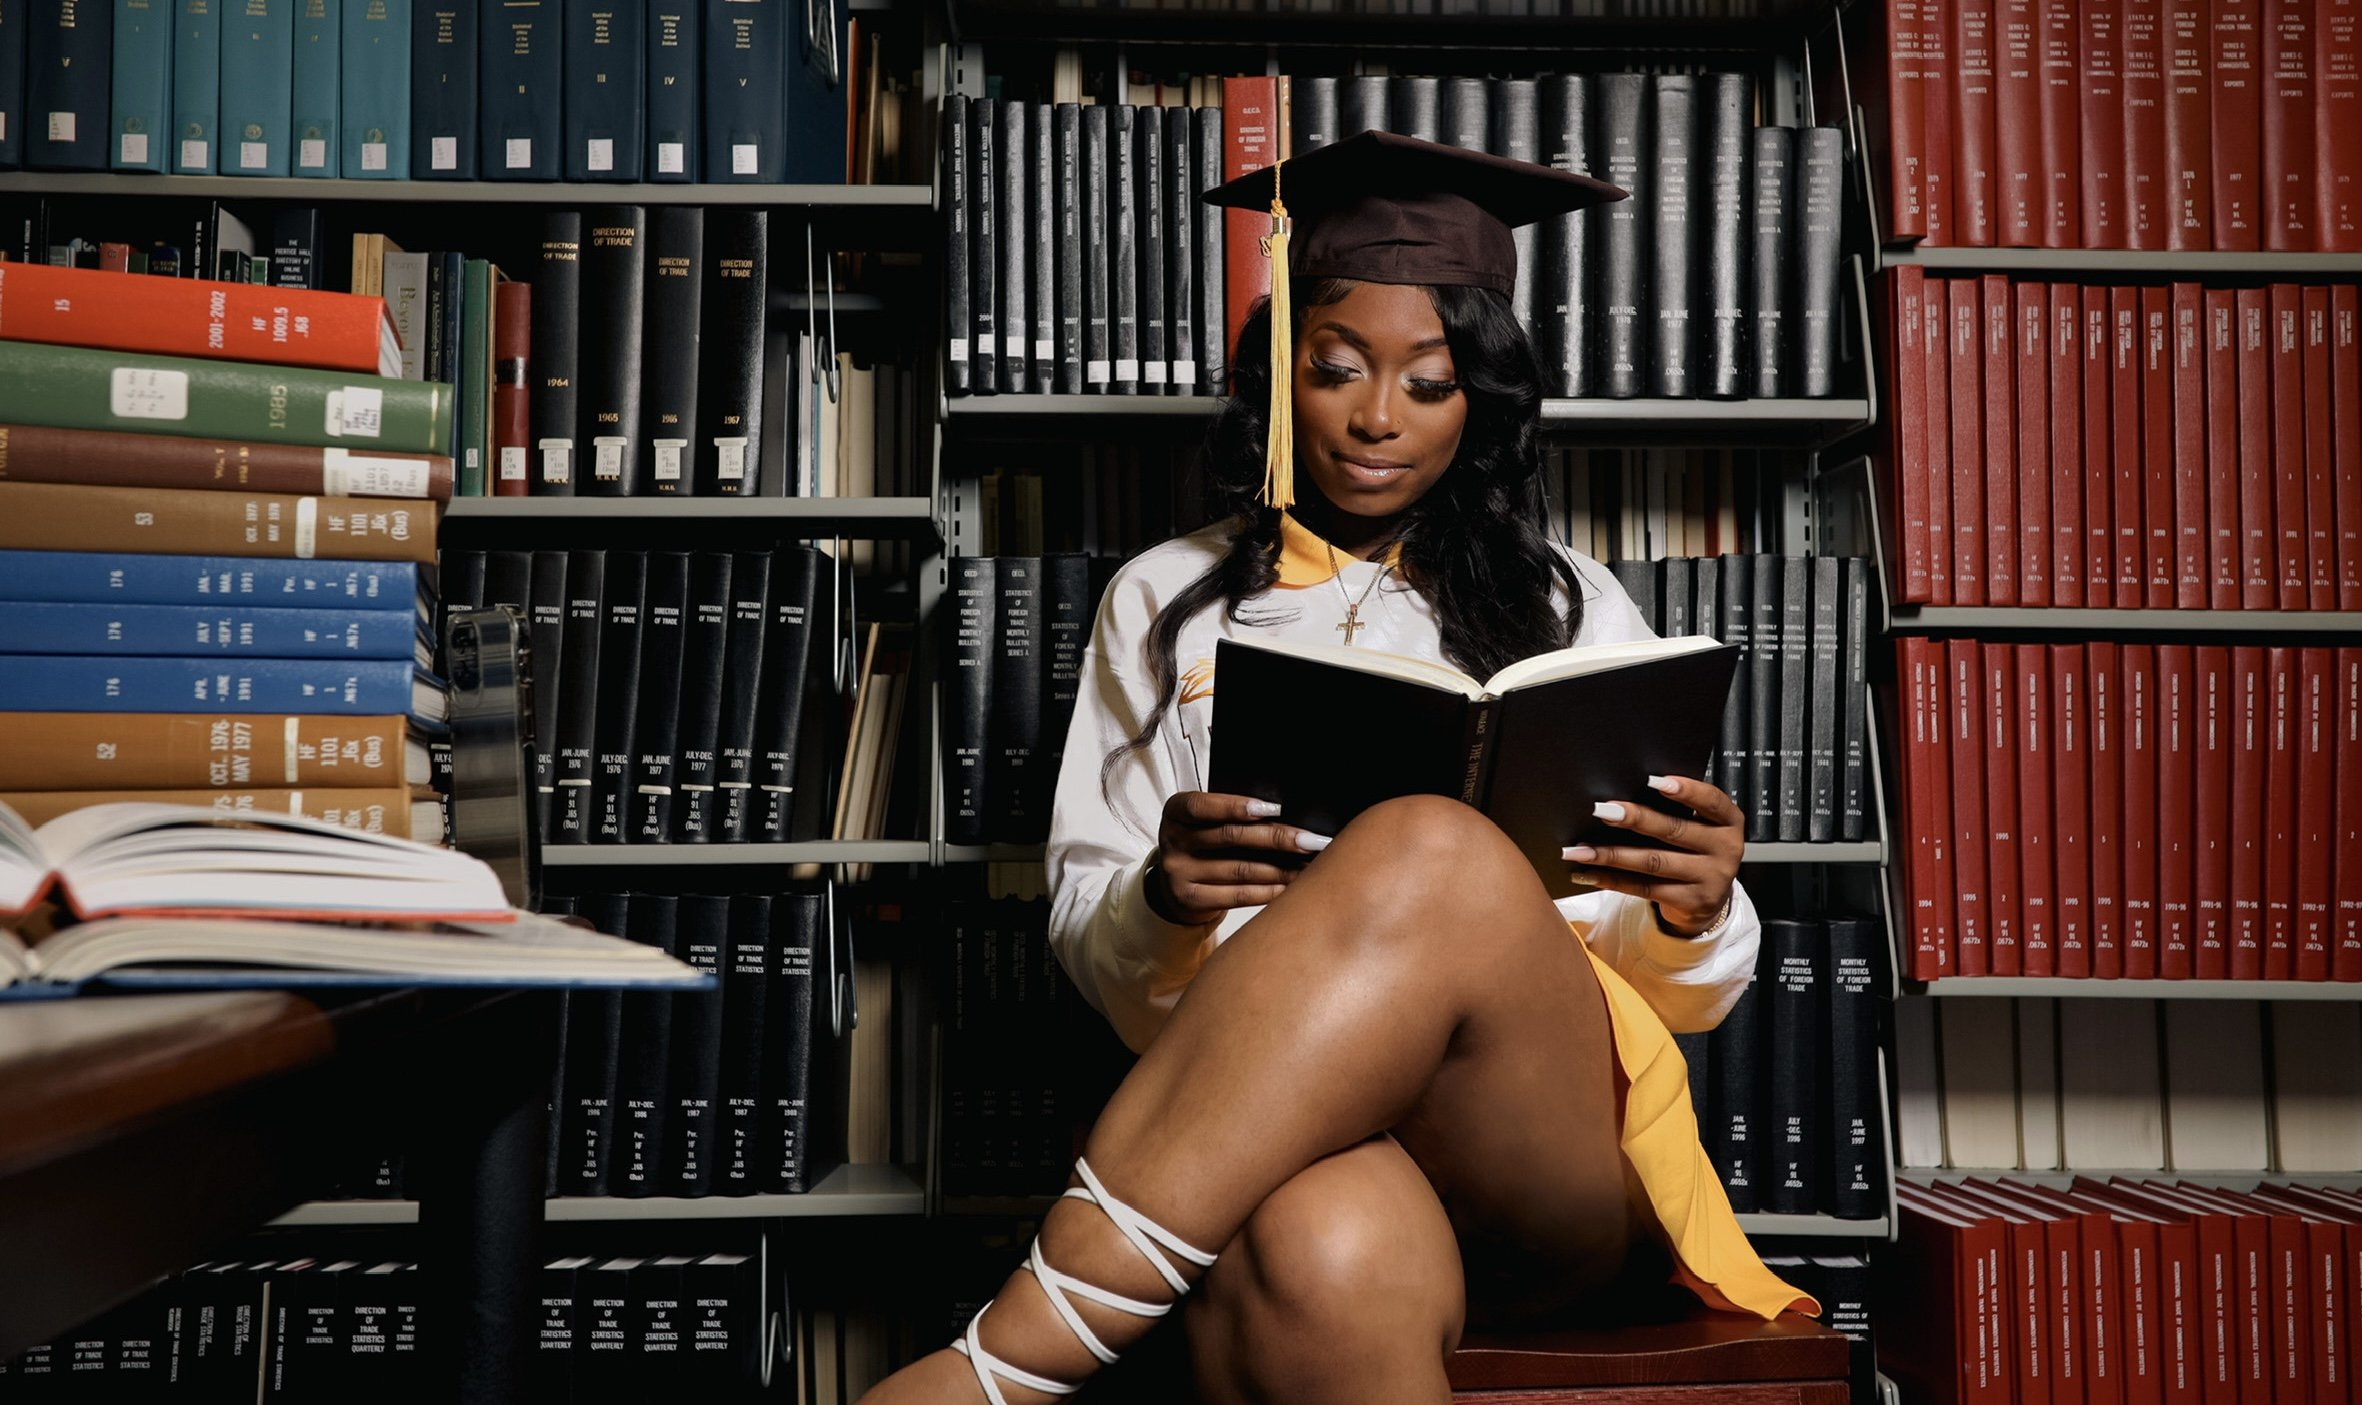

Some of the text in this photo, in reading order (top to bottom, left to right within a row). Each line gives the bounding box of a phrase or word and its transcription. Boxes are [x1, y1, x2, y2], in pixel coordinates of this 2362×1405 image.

[595, 228, 634, 236] DIRECTION
[542, 242, 578, 250] DIRECTION
[594, 238, 632, 246] OF TRADE
[556, 253, 577, 262] TRADE
[659, 258, 690, 266] DIRECTION
[670, 268, 688, 276] TRADE
[55, 300, 70, 311] 15
[208, 290, 226, 348] 2001-2002
[252, 316, 266, 330] HF
[273, 307, 288, 342] 1009.5
[548, 378, 568, 386] 1964
[270, 385, 288, 428] 1985
[599, 413, 618, 422] 1965
[725, 416, 740, 424] 1967
[135, 513, 153, 525] 53
[328, 515, 345, 530] HF
[350, 512, 368, 535] 1101
[390, 510, 410, 540] (Bus)
[246, 525, 258, 542] OCT.
[268, 524, 279, 541] MAY
[241, 572, 253, 592] 1991
[283, 576, 295, 592] Per.
[304, 580, 316, 590] HF
[197, 622, 210, 642] JULY
[240, 623, 253, 644] 1991
[305, 630, 316, 641] HF
[195, 678, 207, 699] APR.
[238, 678, 251, 700] 1991
[303, 685, 314, 695] HF
[97, 743, 116, 758] 52
[232, 722, 252, 781] MAY 1977
[299, 744, 315, 759] HF
[320, 738, 338, 765] 1101
[363, 736, 384, 767] (Bus)
[1469, 743, 1484, 761] THE
[569, 759, 581, 768] 1976
[607, 765, 621, 774] 1976
[208, 758, 230, 784] OCT.
[650, 766, 662, 774] 1977
[568, 800, 575, 808] 91
[607, 804, 614, 813] 91
[563, 820, 579, 830] (Bus)
[602, 824, 617, 834] (Bus)
[643, 826, 659, 835] (Bus)
[695, 1342, 728, 1350] QUARTERLY
